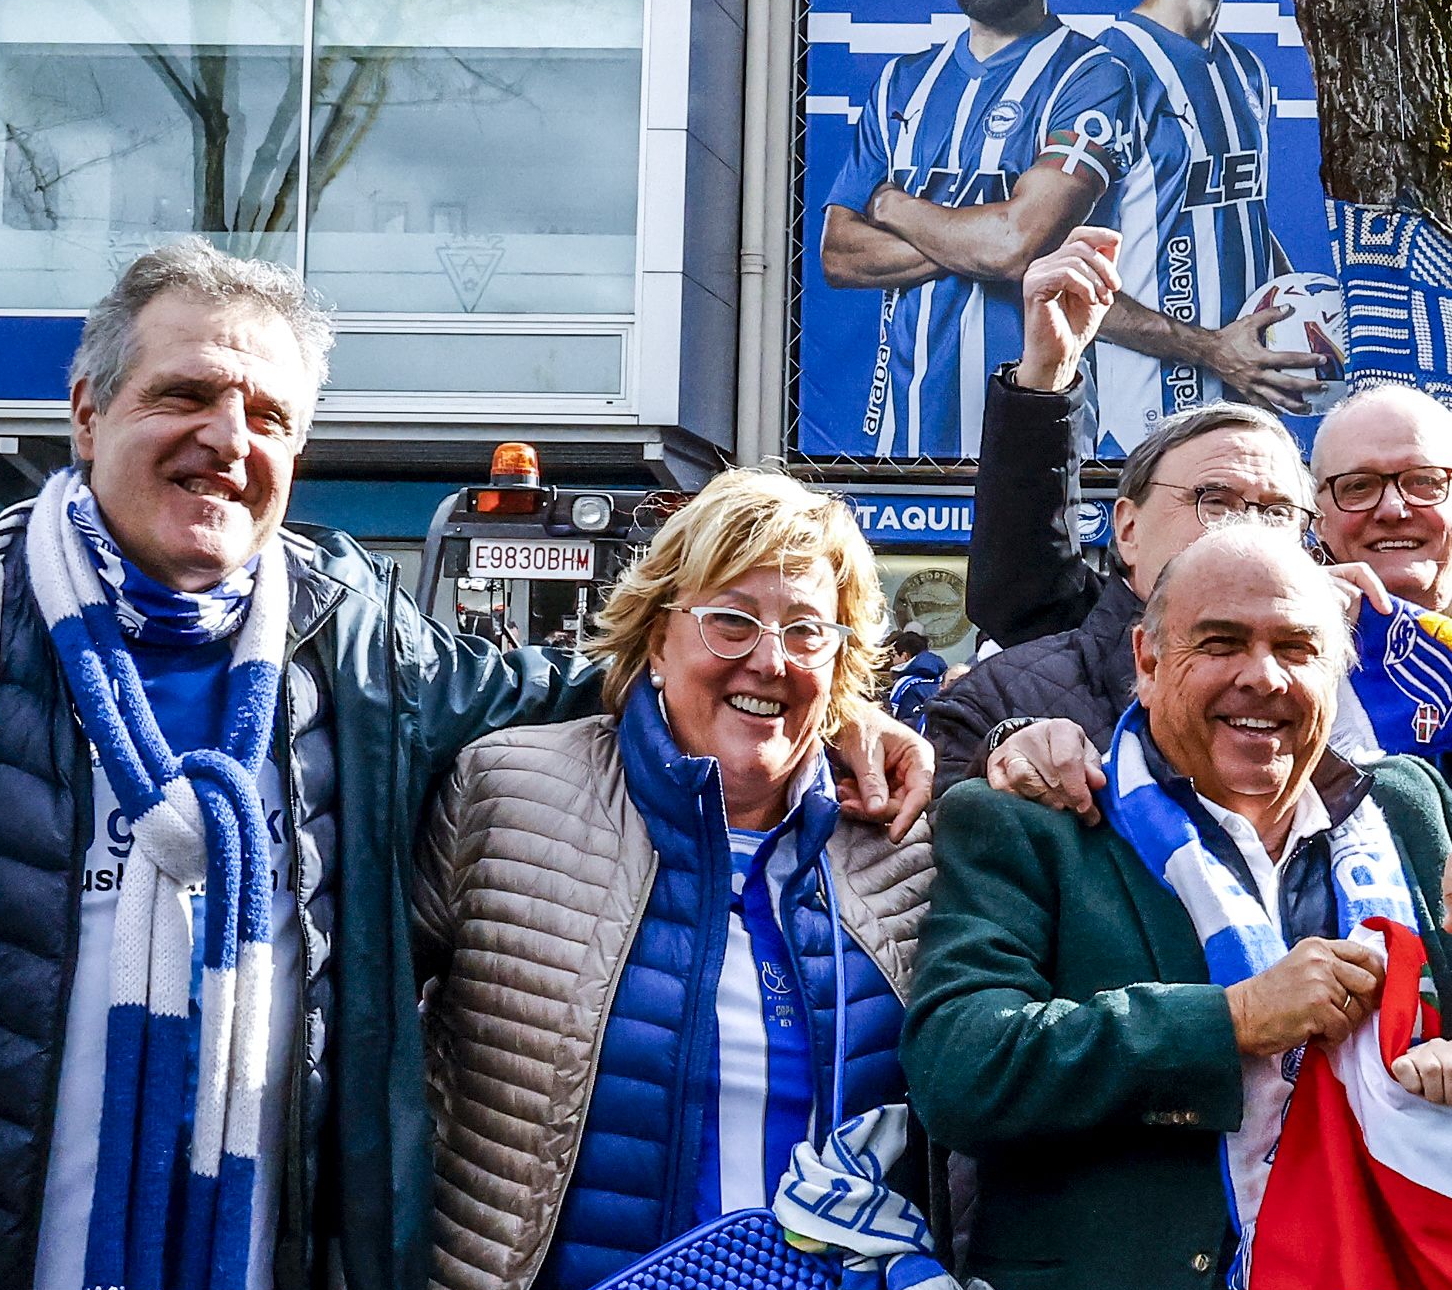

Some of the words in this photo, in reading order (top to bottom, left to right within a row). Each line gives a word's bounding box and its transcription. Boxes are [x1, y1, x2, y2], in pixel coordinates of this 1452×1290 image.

[1180, 149, 1267, 213] LE
[1166, 364, 1198, 412] rab
[475, 546, 589, 571] E9830BHM
